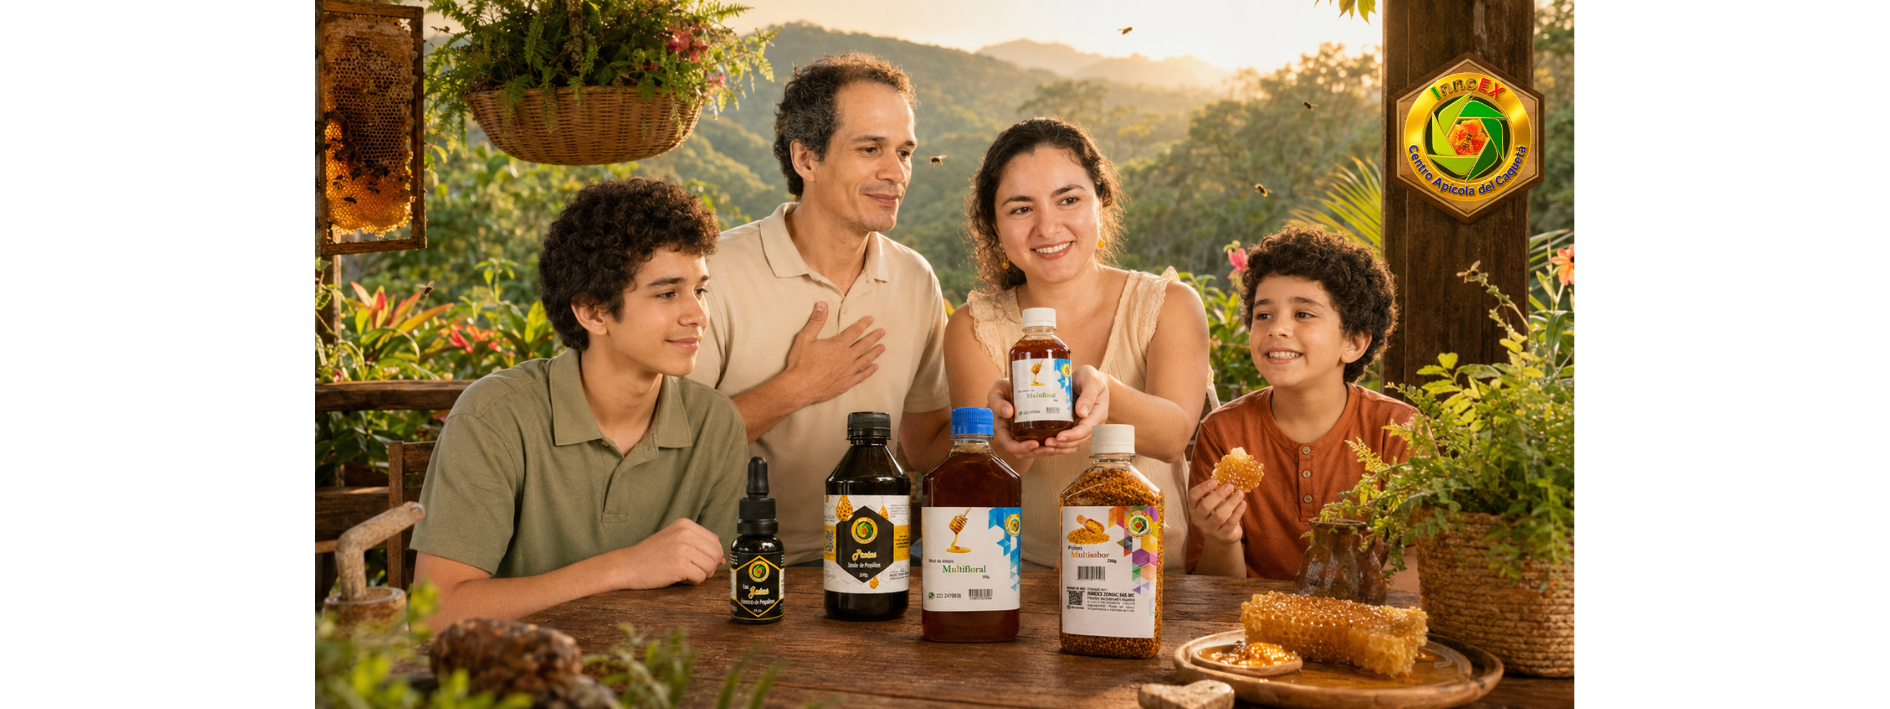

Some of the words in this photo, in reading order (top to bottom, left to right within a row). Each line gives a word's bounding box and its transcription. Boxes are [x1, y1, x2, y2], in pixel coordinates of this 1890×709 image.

[1430, 77, 1506, 99] InnoEX
[1408, 144, 1433, 180] Centro
[1432, 176, 1475, 196] Apícola
[1478, 180, 1496, 194] del
[1495, 144, 1527, 186] Caquetá
[1071, 550, 1110, 558] Multisabor
[942, 565, 986, 573] Multifloral
